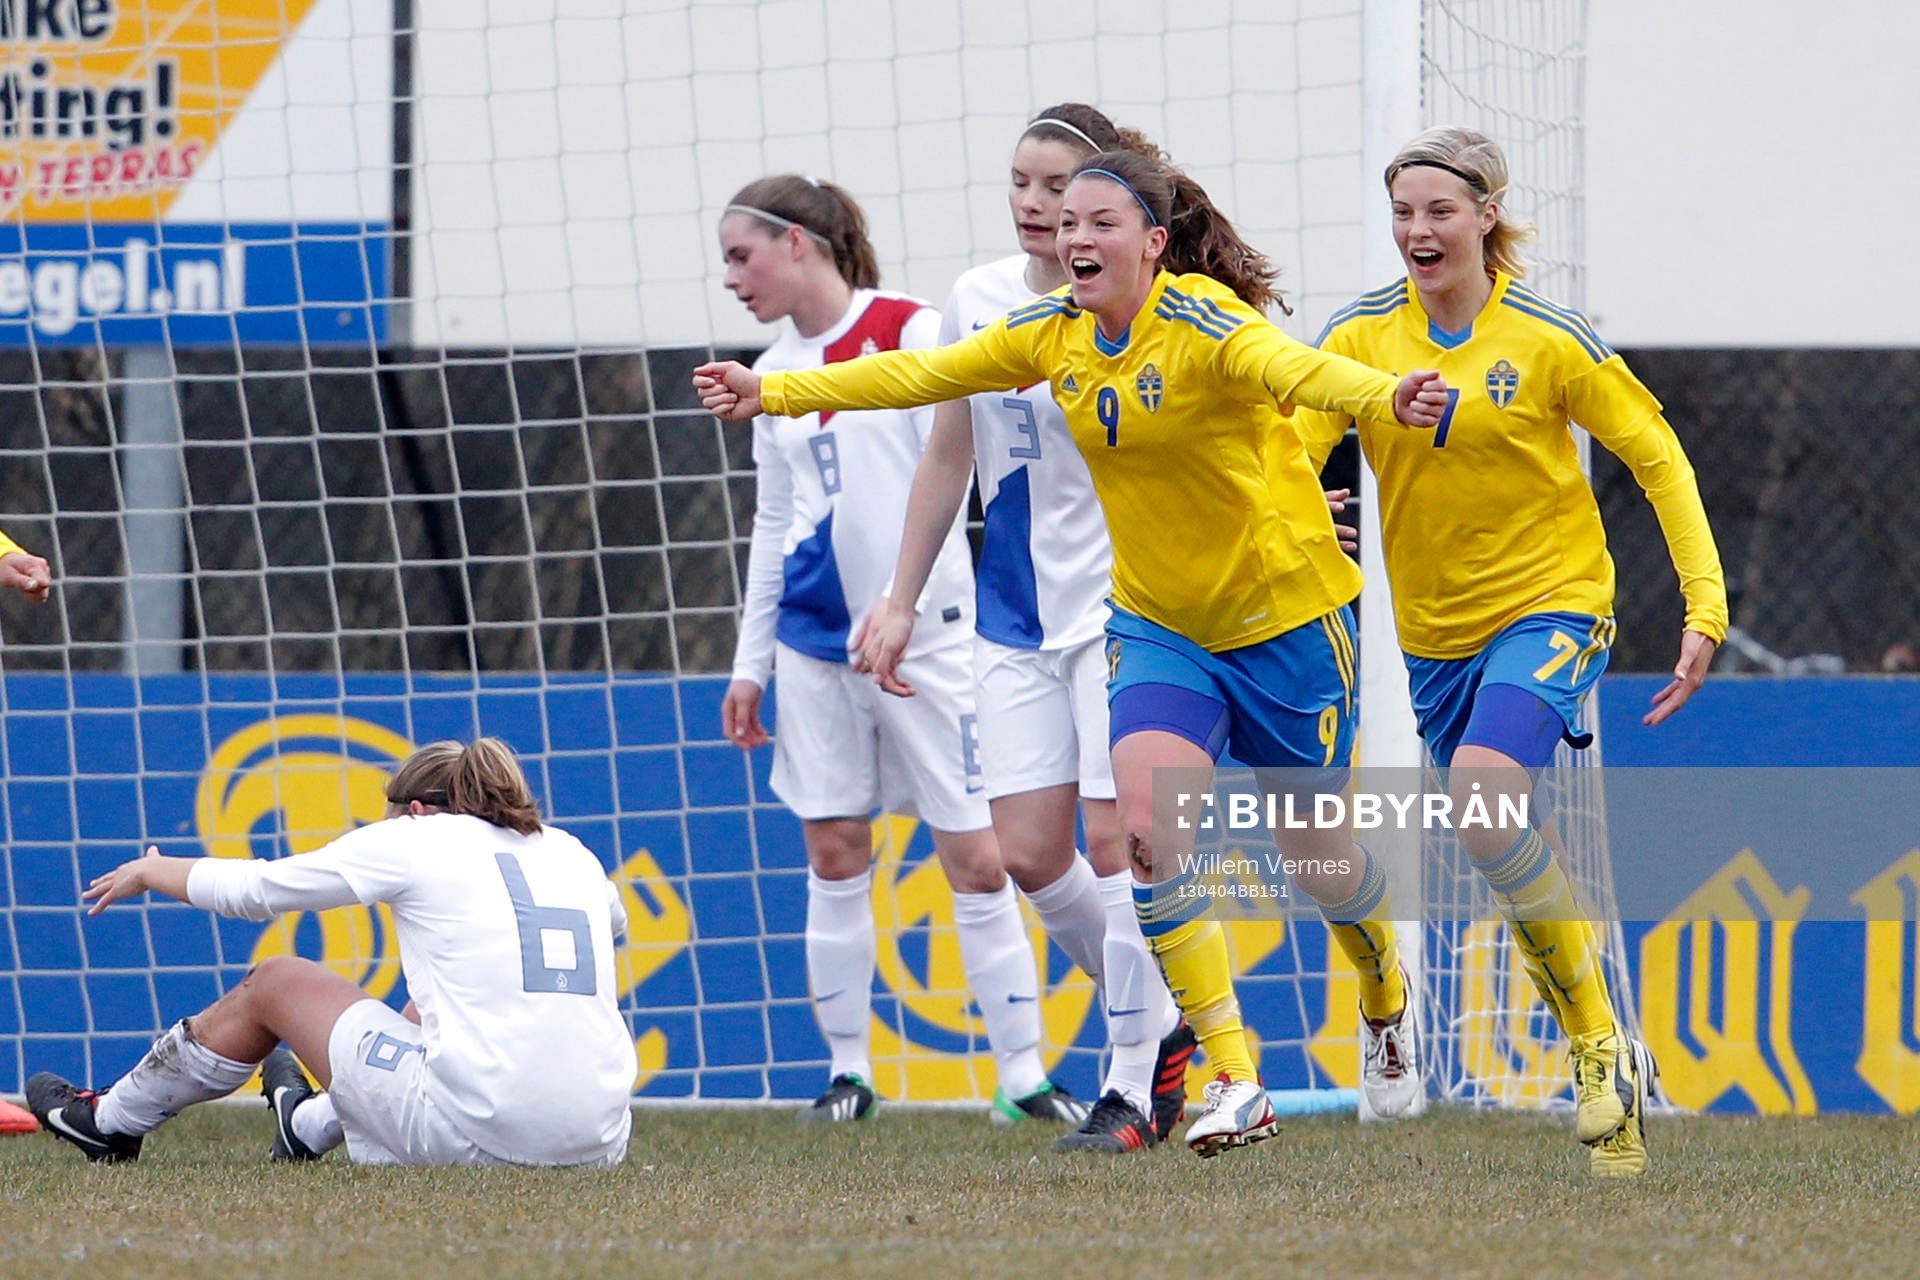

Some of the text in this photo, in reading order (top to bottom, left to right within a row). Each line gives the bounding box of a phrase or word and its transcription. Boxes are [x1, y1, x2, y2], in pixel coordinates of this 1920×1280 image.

[39, 145, 200, 196] TERRAS
[1003, 398, 1042, 459] 3
[1097, 386, 1119, 447] 9
[808, 431, 841, 496] 8
[1532, 629, 1579, 682] 7
[1317, 704, 1339, 768] 9
[495, 853, 597, 996] 6
